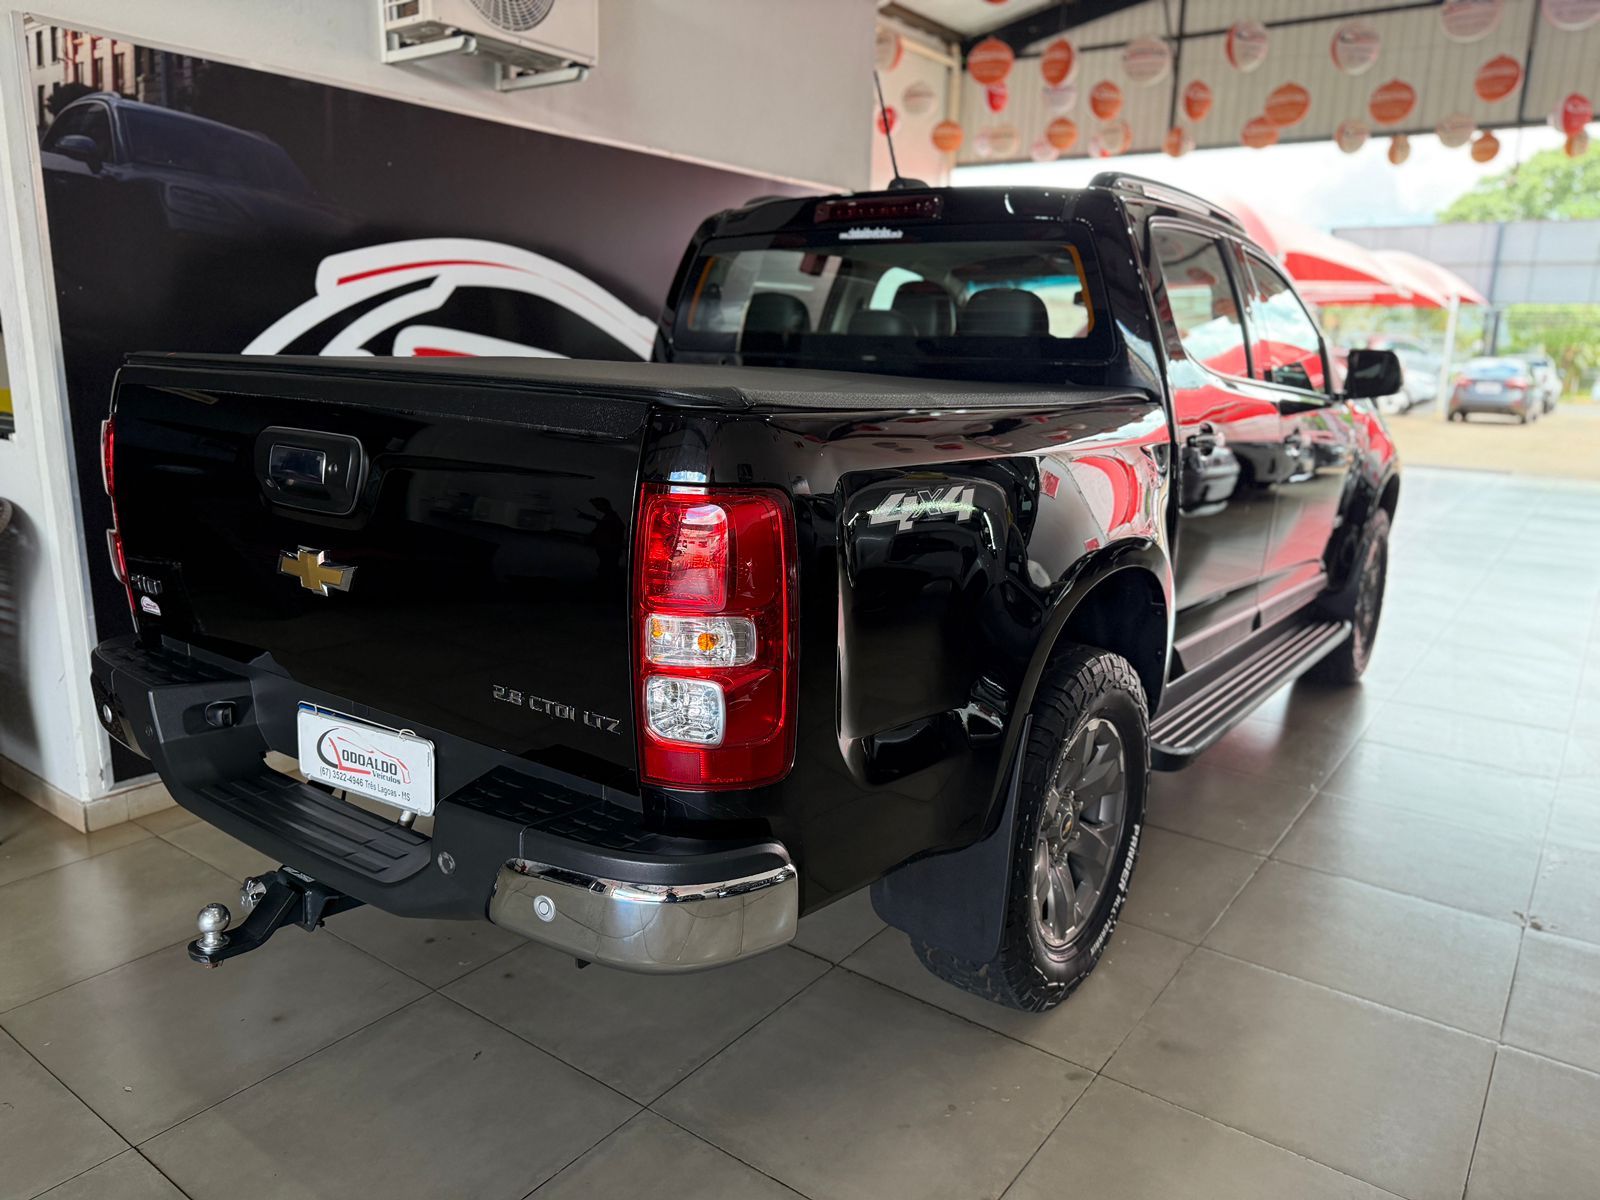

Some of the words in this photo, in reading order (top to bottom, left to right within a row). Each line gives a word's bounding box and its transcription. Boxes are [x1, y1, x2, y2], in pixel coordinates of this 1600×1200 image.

[583, 710, 621, 735] LTZ
[319, 766, 331, 780] (67)
[332, 771, 364, 788] 3522-4946
[377, 783, 397, 798] Lagoas
[401, 792, 411, 801] MS
